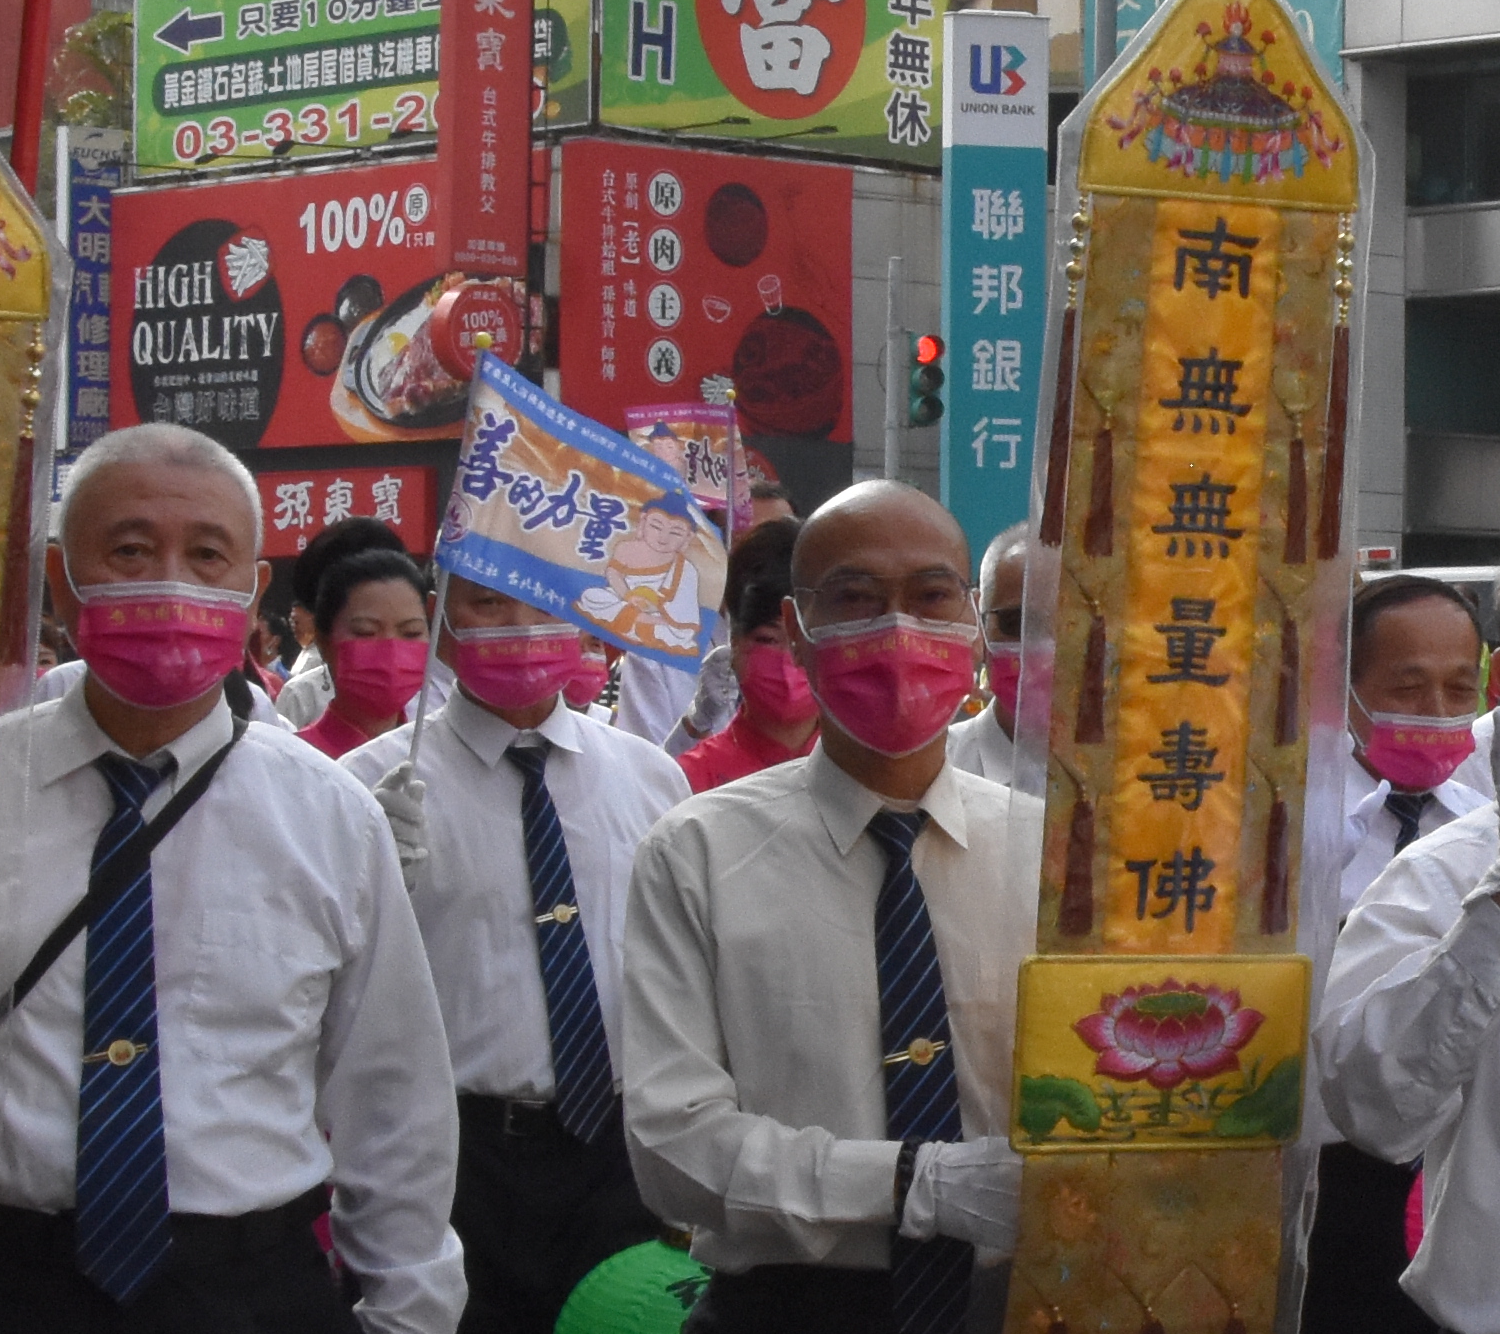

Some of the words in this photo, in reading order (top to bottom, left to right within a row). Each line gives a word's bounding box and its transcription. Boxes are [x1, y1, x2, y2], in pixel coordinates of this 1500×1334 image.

[959, 101, 996, 116] UNION
[999, 102, 1036, 117] BANK
[478, 85, 498, 215] 台式牛排教父
[299, 189, 405, 254] 100%
[408, 192, 424, 218] 原
[133, 260, 214, 311] HIGH
[652, 179, 677, 378] 原肉主義
[131, 311, 280, 367] QUALITY
[461, 309, 504, 330] 100%
[970, 188, 1024, 470] 聯邦銀行
[456, 411, 628, 562] 善的力量
[1122, 215, 1260, 933] 南無無量壽佛
